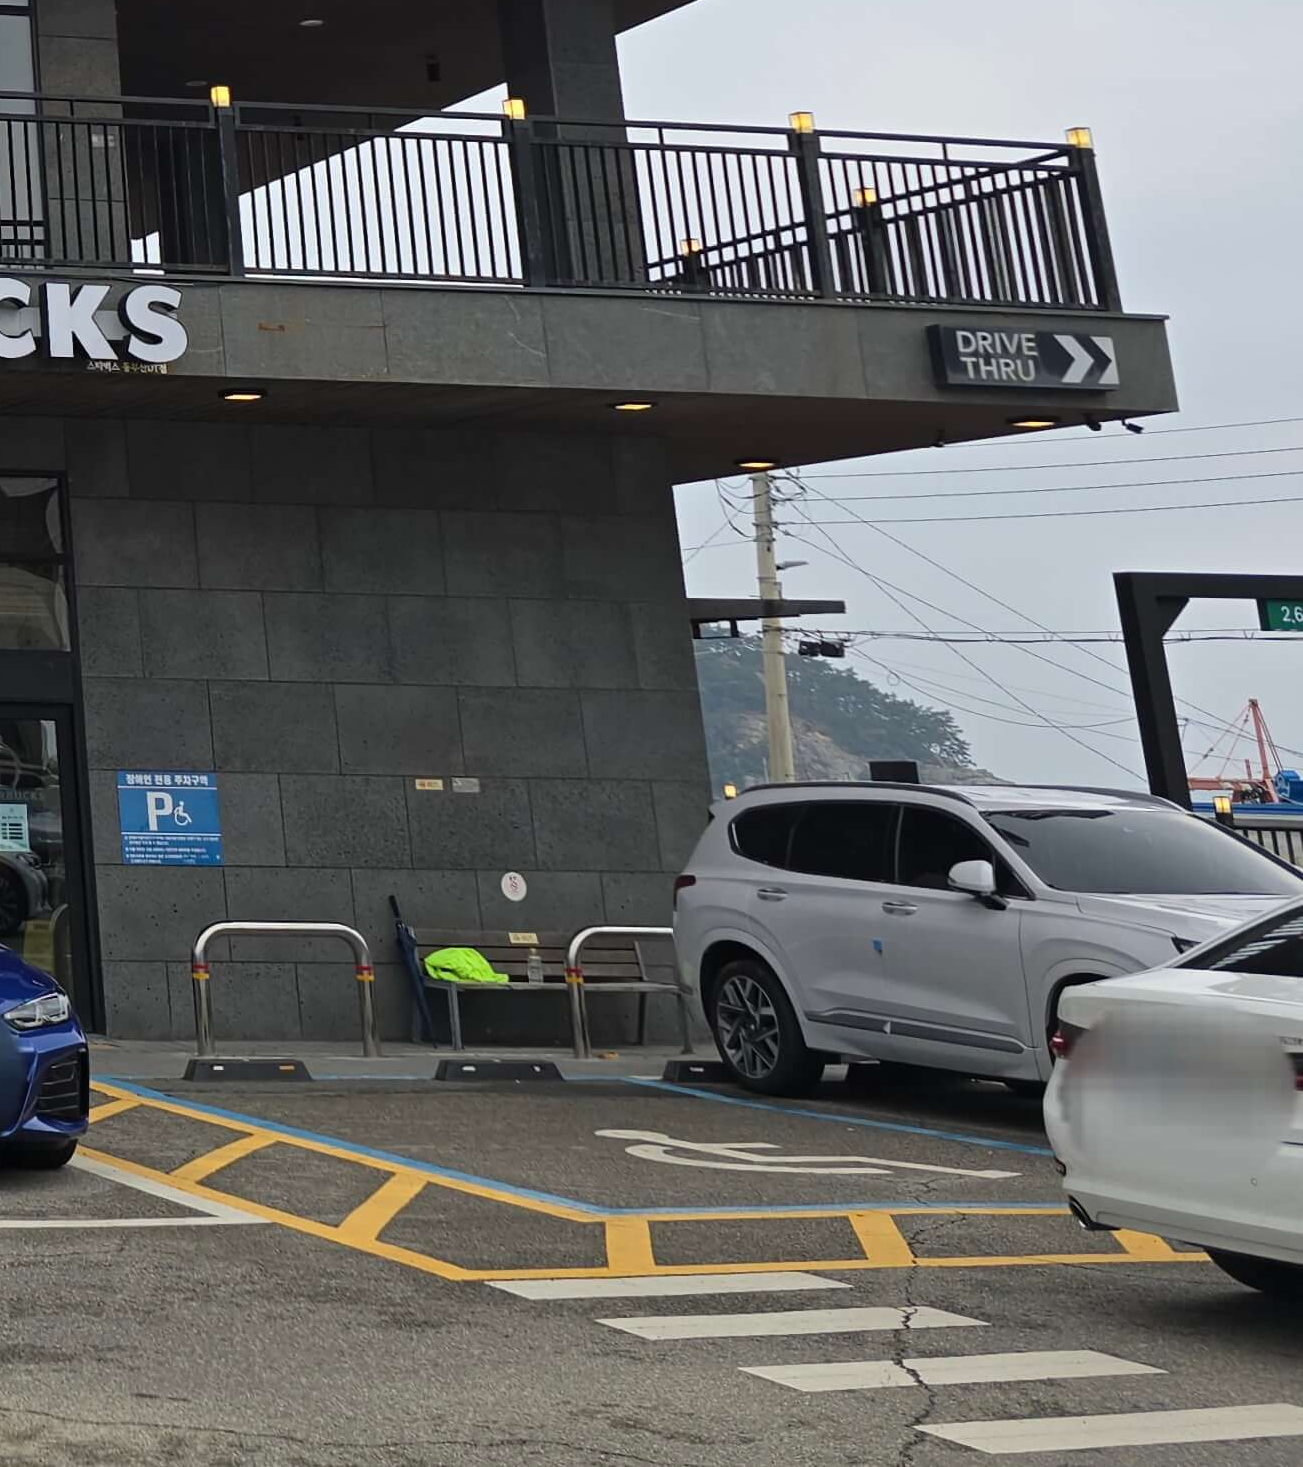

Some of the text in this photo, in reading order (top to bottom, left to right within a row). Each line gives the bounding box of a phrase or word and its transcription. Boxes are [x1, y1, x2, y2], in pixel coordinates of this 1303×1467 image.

[955, 330, 1039, 357] DRIVE
[960, 357, 1037, 382] THRU
[125, 773, 153, 785] 장애인
[174, 774, 209, 786] 주차구역
[146, 791, 173, 831] P
